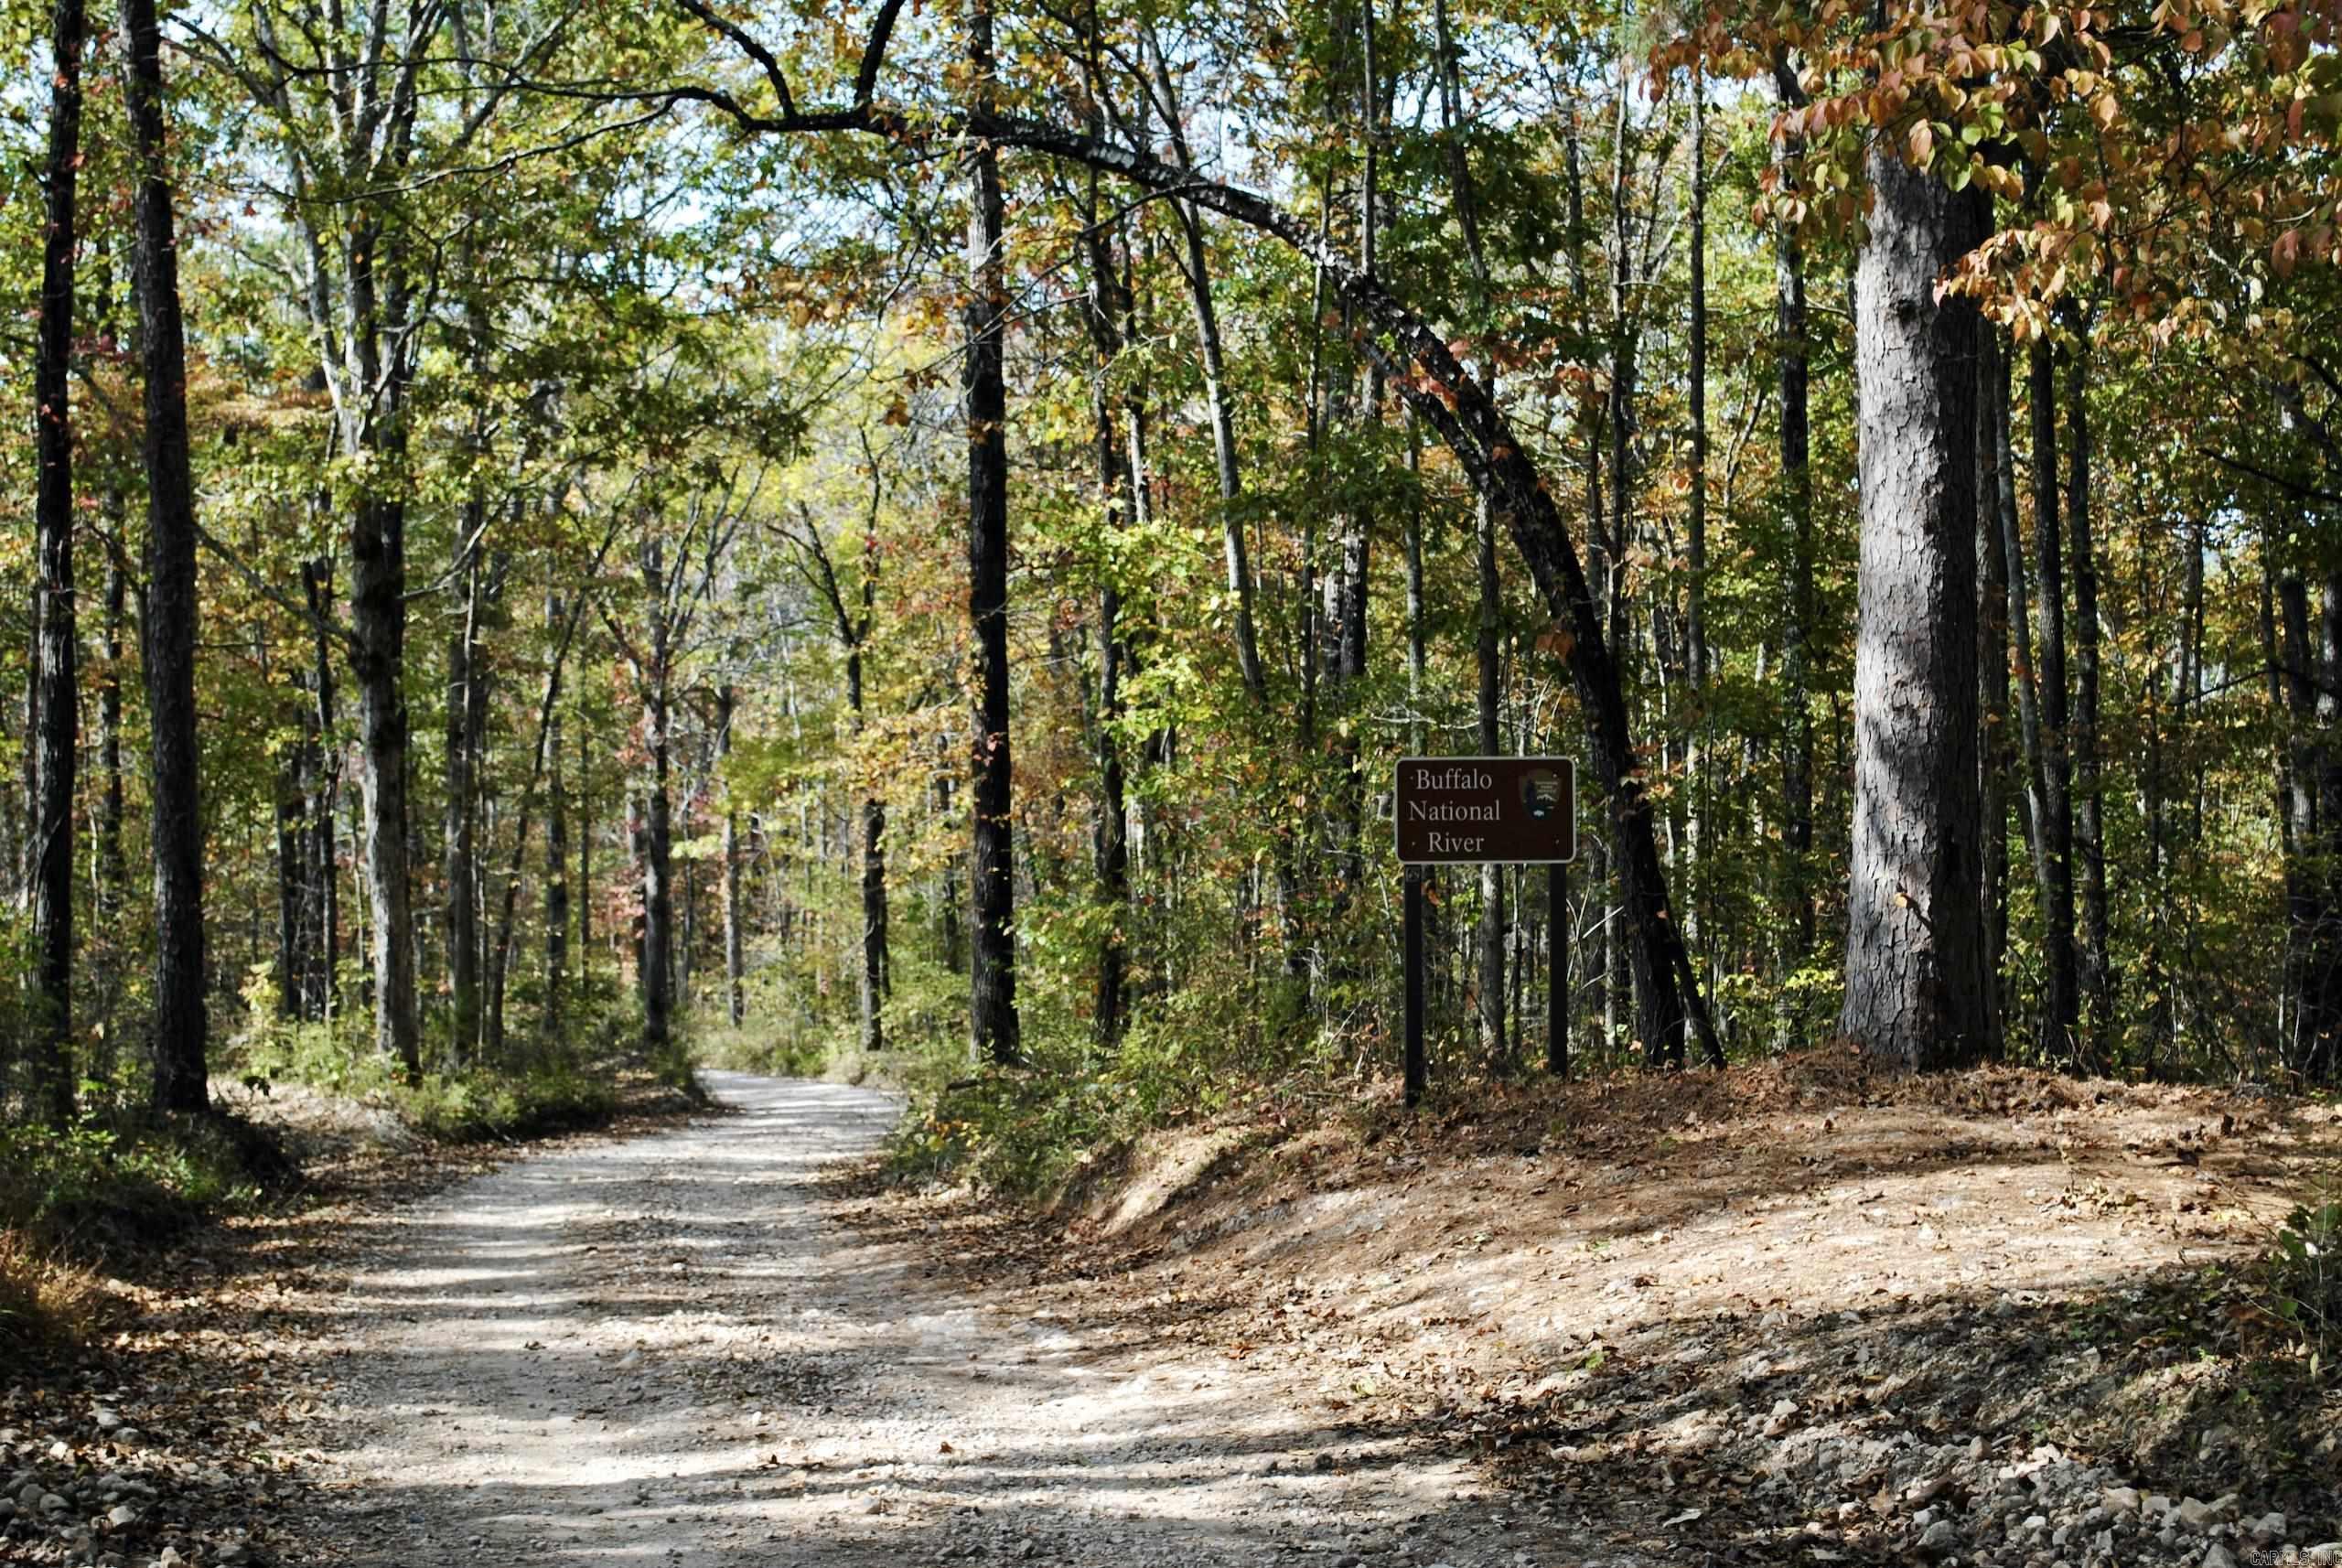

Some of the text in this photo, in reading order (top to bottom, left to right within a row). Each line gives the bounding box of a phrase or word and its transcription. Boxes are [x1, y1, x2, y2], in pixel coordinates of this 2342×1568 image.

[1416, 768, 1492, 789] Buffalo
[1409, 799, 1500, 821] National
[1428, 832, 1484, 853] River
